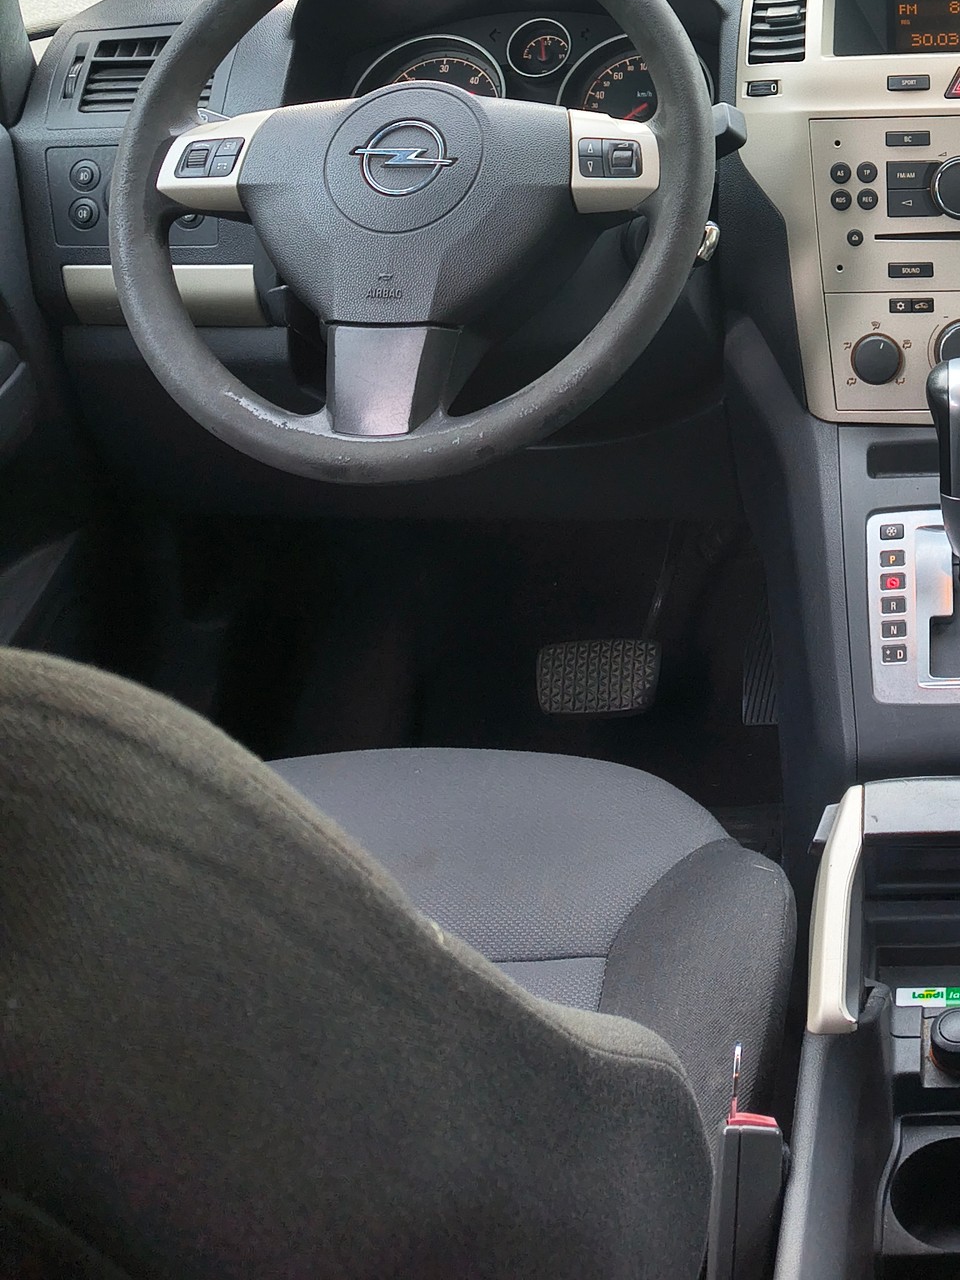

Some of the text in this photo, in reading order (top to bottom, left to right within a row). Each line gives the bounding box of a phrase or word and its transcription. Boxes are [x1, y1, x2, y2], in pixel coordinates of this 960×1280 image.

[898, 3, 918, 15] FM
[439, 64, 450, 73] 30
[469, 76, 480, 85] 40
[613, 71, 624, 80] 60
[594, 90, 605, 100] 40
[889, 555, 896, 565] P
[890, 601, 897, 611] R
[890, 624, 898, 635] N
[896, 649, 904, 659] D
[912, 990, 944, 999] Landi
